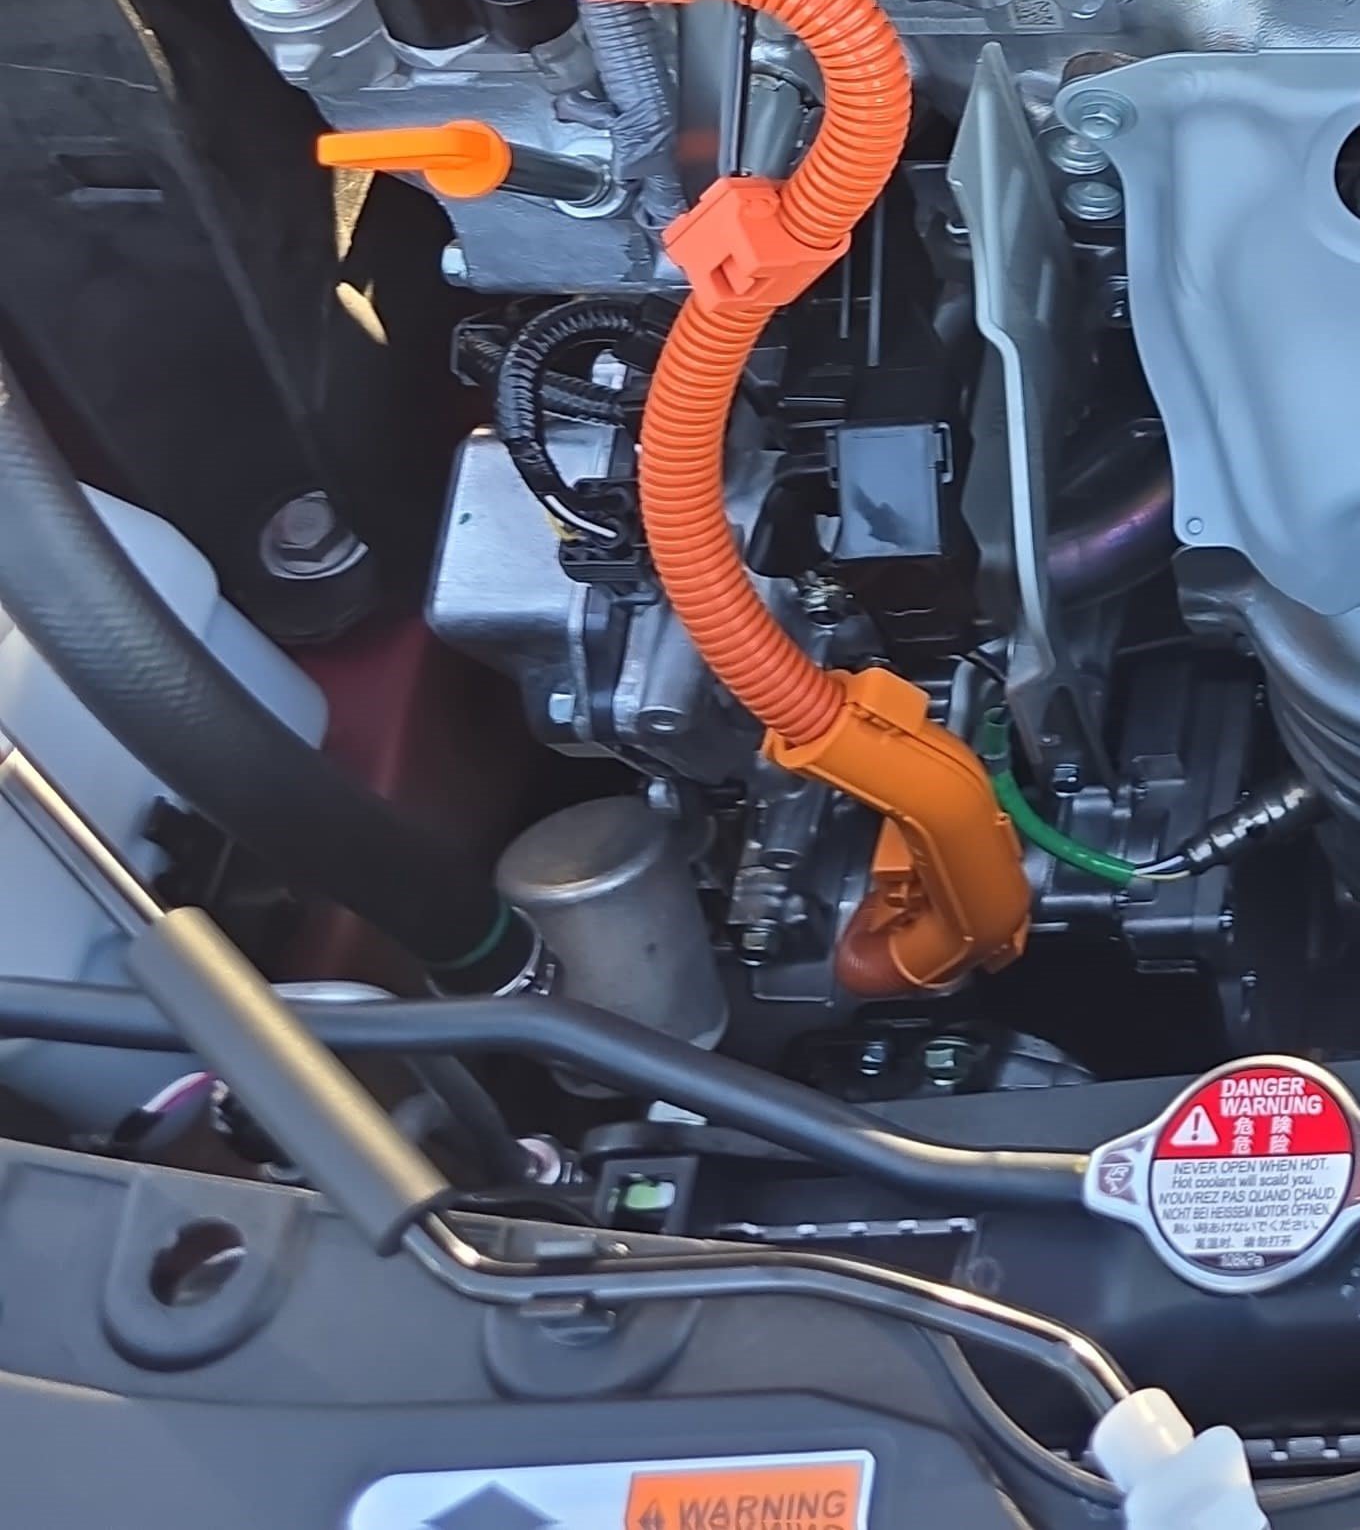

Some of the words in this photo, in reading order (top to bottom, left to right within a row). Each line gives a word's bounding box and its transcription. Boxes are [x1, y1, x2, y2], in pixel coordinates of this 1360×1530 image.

[1221, 1077, 1305, 1097] DANGER
[1220, 1095, 1323, 1117] WARNUNG
[1174, 1162, 1217, 1174] NEVER
[1221, 1161, 1256, 1174] OPEN
[1260, 1159, 1297, 1172] WHEN
[1301, 1157, 1329, 1170] HOT.
[1172, 1176, 1192, 1188] Hot
[1195, 1176, 1236, 1188] coolant
[1239, 1174, 1257, 1186] will
[1260, 1174, 1289, 1186] scald
[1222, 1191, 1246, 1203] PAS
[1249, 1189, 1291, 1202] QUAND
[1162, 1207, 1191, 1220] NICHT
[1193, 1207, 1208, 1219] BEI
[1254, 1205, 1289, 1217] MOTOR
[680, 1490, 847, 1521] WARNING
